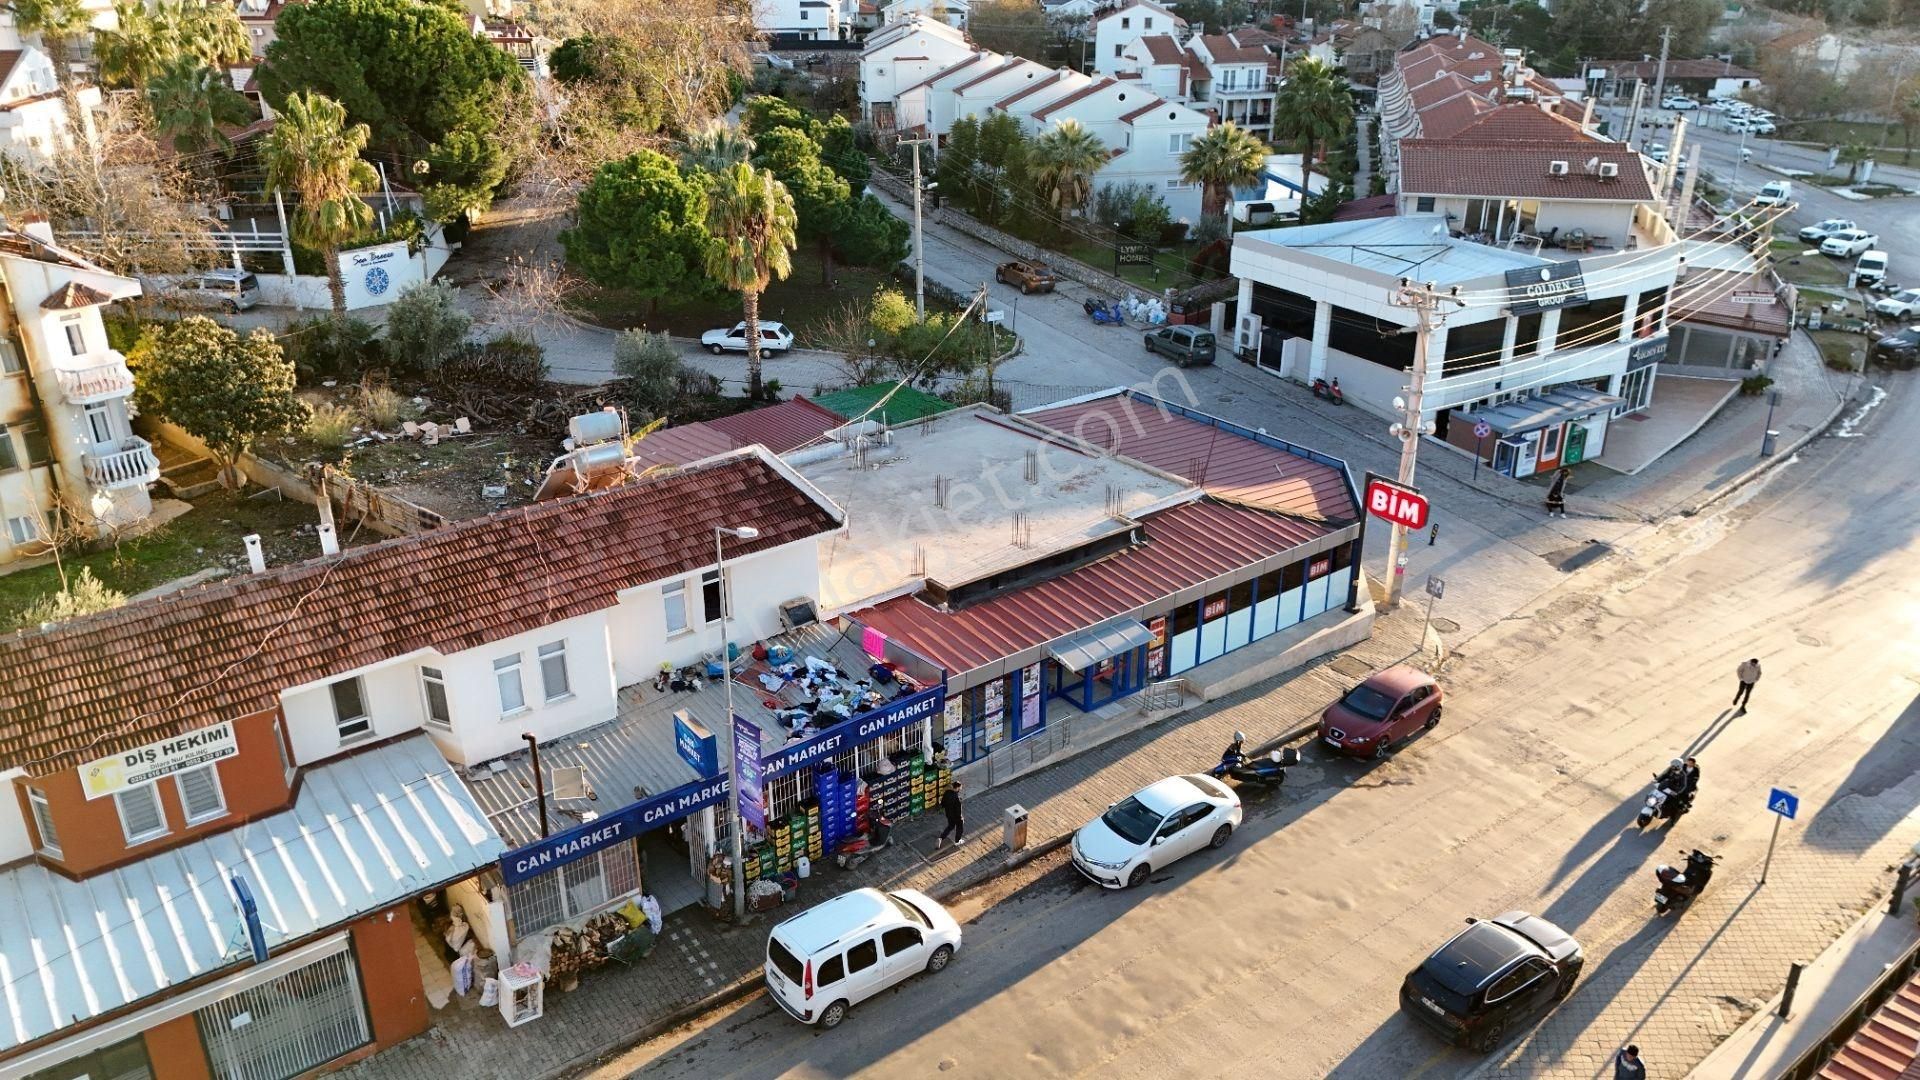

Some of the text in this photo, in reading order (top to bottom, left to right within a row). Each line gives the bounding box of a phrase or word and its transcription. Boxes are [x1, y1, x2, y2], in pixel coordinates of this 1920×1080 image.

[1526, 280, 1570, 298] GOLDEN
[1538, 296, 1566, 307] GROUP
[1371, 488, 1420, 524] BİM
[1205, 601, 1224, 616] BİM
[859, 697, 936, 736] CAN MARKET
[125, 724, 229, 767] DİŞ HEKİMİ
[171, 755, 184, 763] Nur
[788, 734, 842, 766] MARKET
[644, 780, 730, 823] CAN MARKE
[516, 822, 622, 874] CAN MARKET
